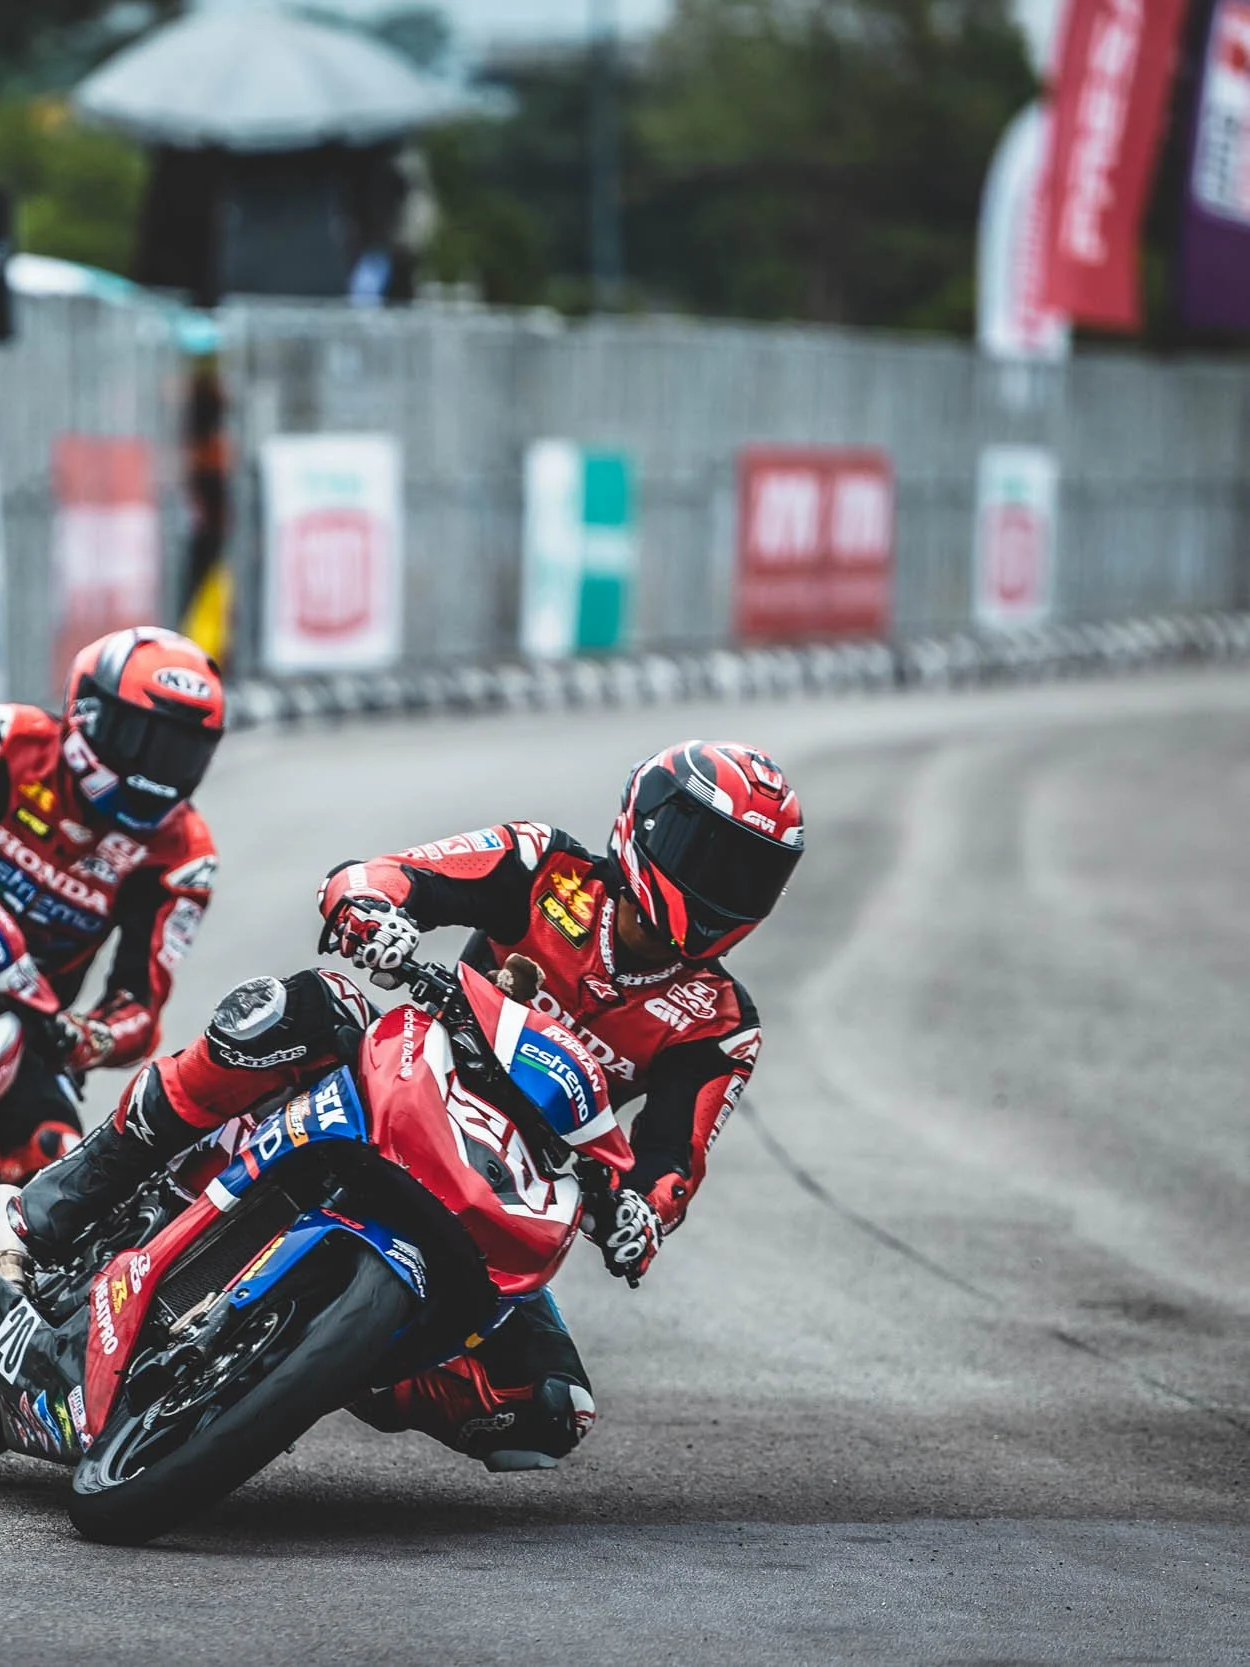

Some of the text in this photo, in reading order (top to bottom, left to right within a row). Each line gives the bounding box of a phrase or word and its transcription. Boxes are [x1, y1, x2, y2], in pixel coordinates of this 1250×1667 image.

[530, 990, 636, 1081] ONDA
[314, 1081, 349, 1131] SCK
[521, 1043, 589, 1122] estremo
[95, 1277, 119, 1355] HEATPRO
